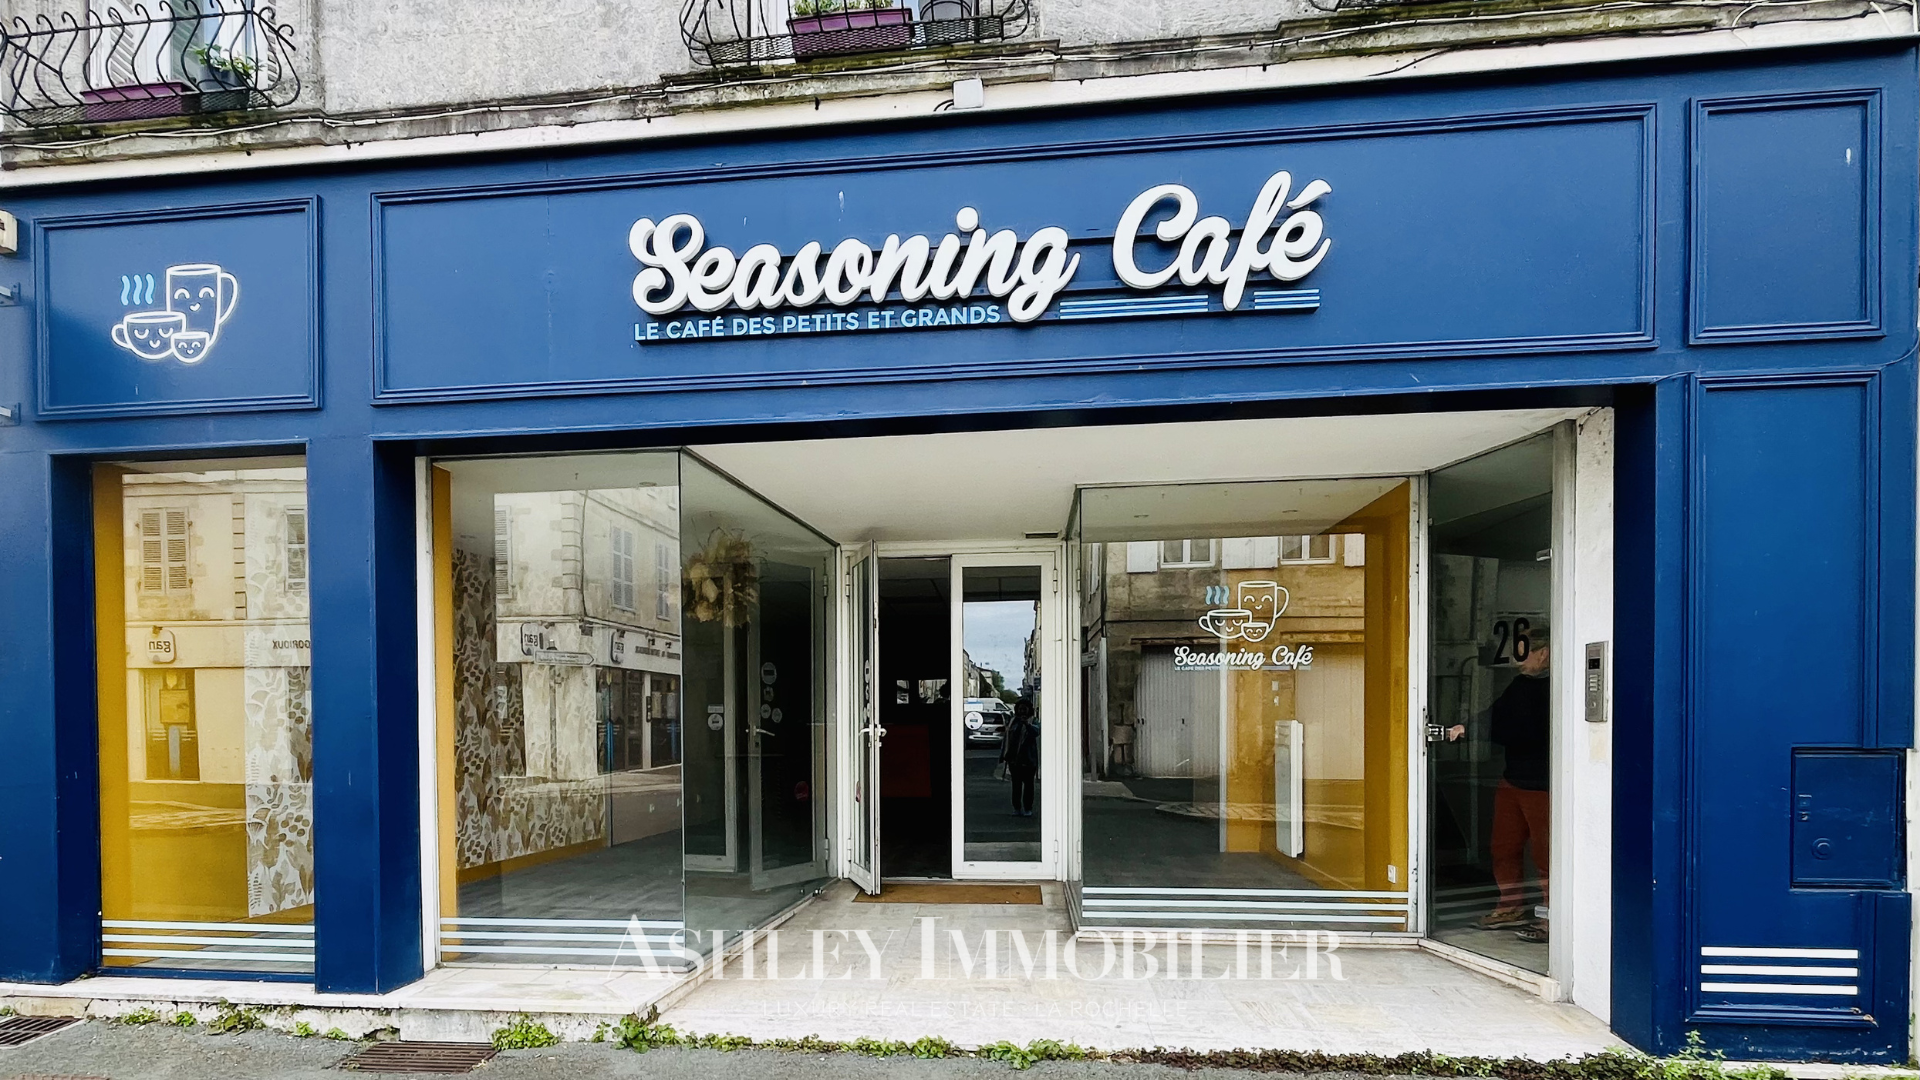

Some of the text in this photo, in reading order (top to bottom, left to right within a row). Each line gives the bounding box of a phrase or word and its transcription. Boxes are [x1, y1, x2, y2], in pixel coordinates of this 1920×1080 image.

[628, 169, 1332, 323] Seasoning Café
[634, 305, 1001, 341] LE CAFÉ DES PETITS ET GRANDS
[1173, 644, 1314, 671] Seasoning Café
[1493, 617, 1530, 665] 26
